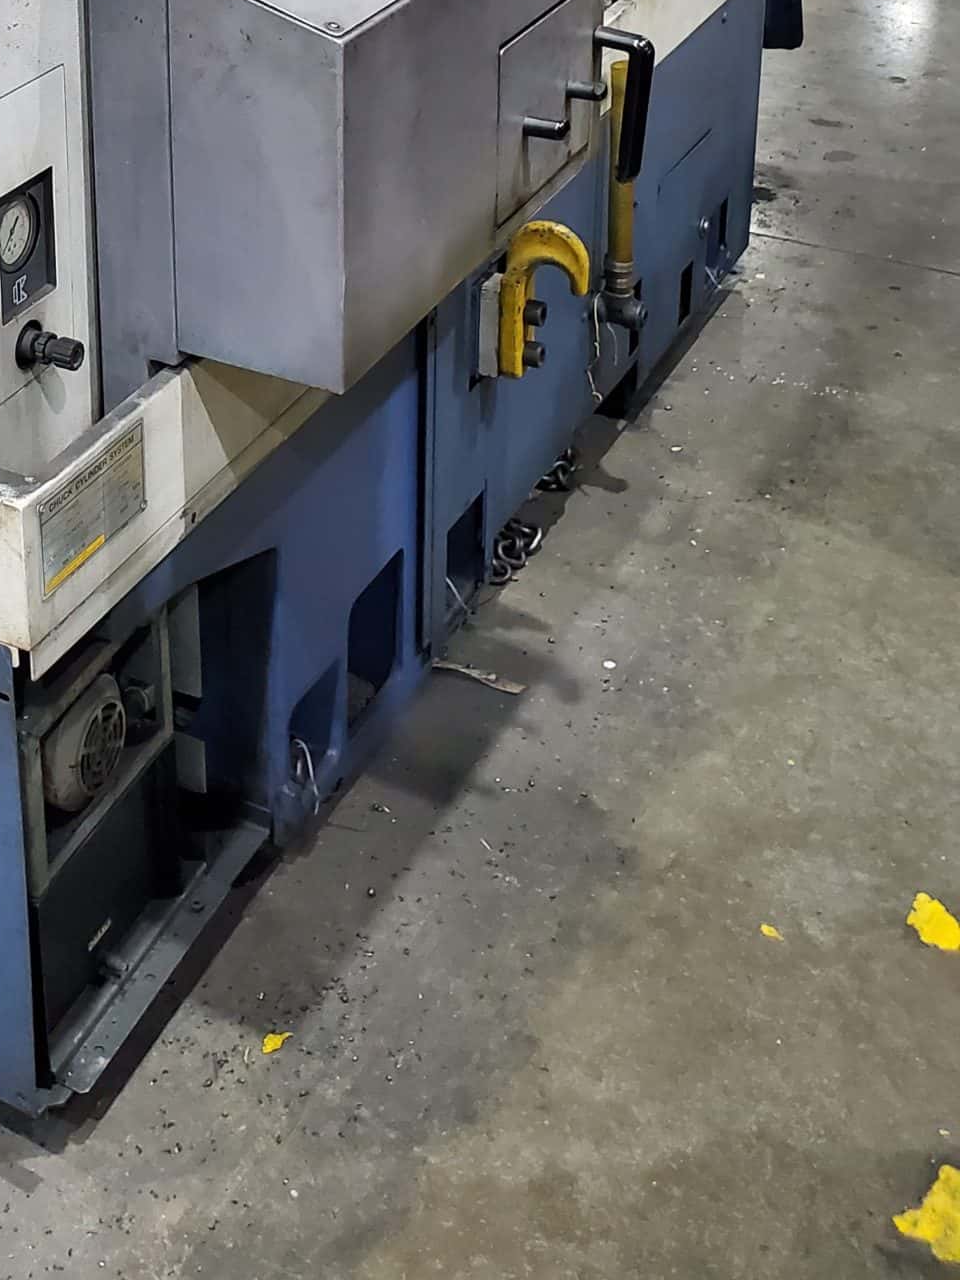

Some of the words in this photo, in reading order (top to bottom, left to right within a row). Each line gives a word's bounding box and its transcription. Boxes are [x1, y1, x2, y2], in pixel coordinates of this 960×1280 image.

[48, 487, 73, 513] CHUCK
[75, 457, 108, 490] CYLINDER
[109, 434, 135, 462] SYSTEM
